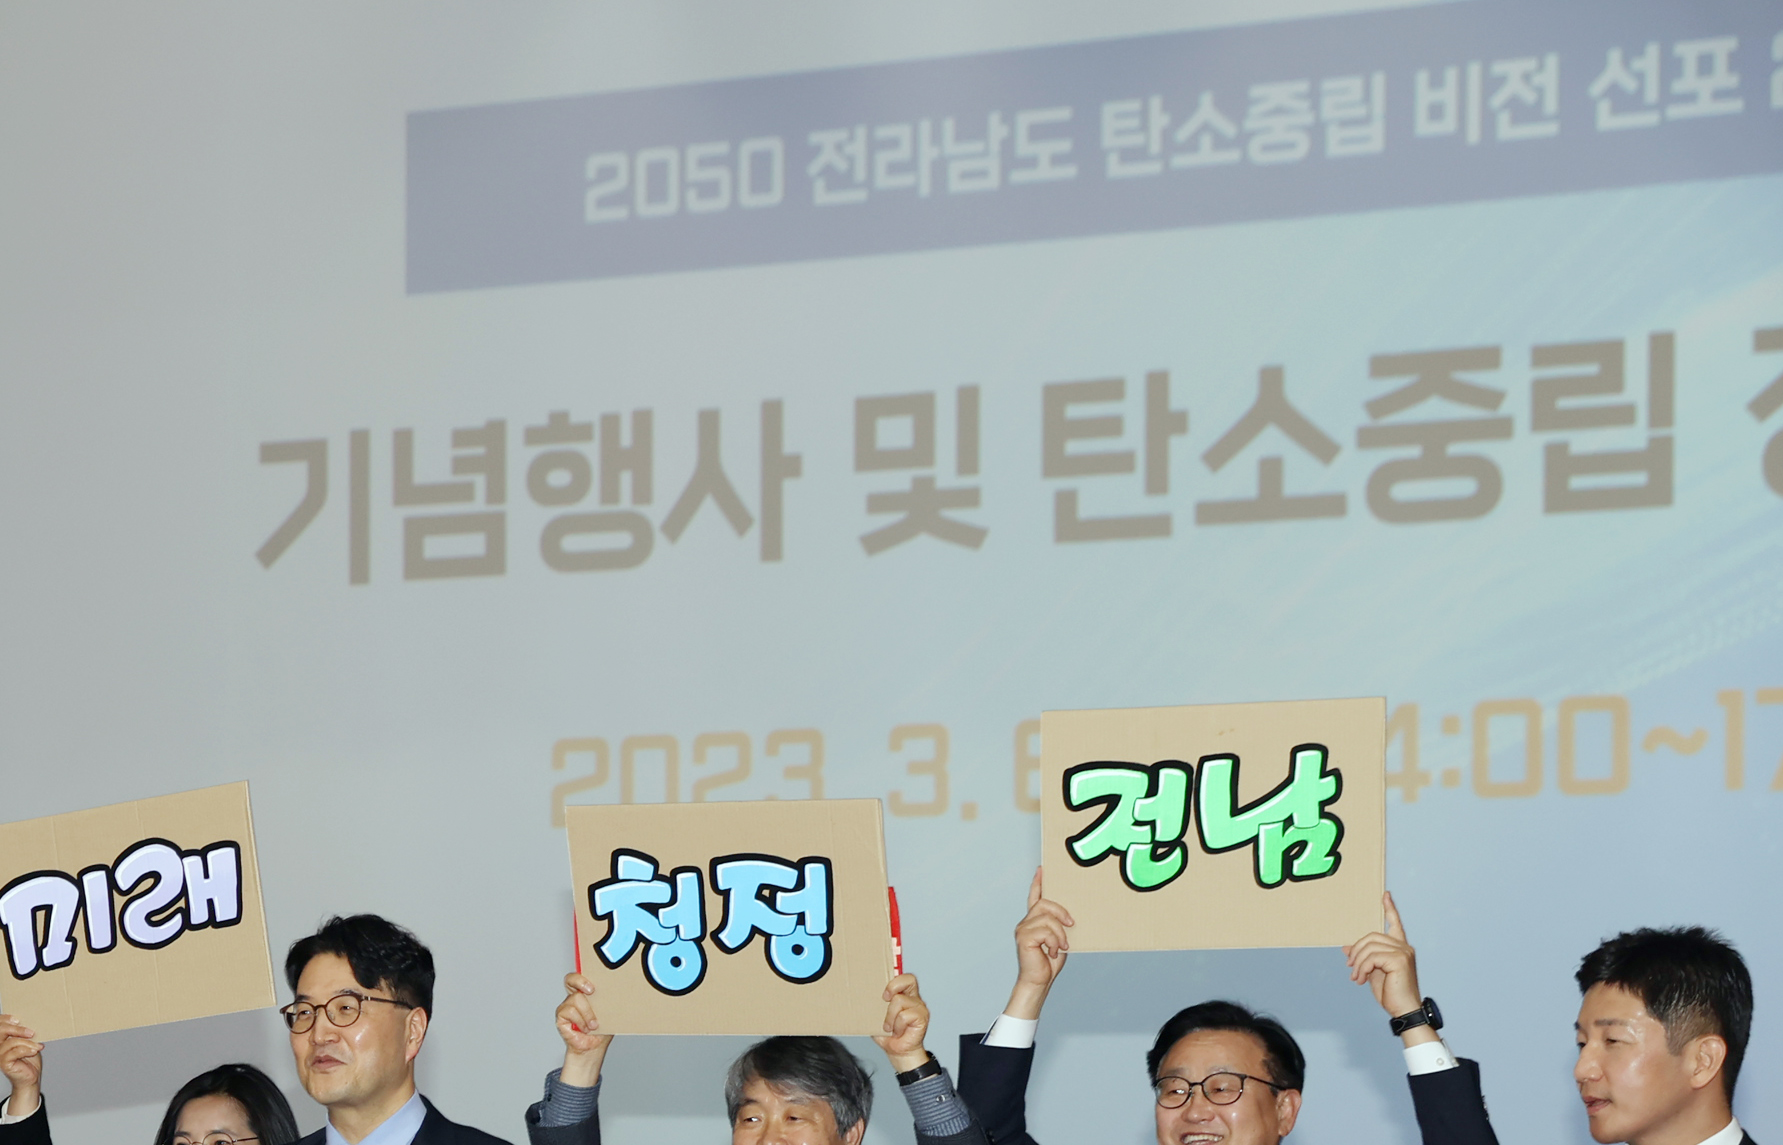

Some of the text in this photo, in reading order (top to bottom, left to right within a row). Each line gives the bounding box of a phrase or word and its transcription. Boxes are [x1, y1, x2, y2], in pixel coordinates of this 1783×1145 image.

[584, 137, 785, 224] 2050
[806, 108, 1079, 207] 전라남도
[1100, 72, 1387, 179] 탄소중립
[1414, 52, 1562, 146] 비전
[1586, 36, 1746, 131] 선포
[254, 397, 804, 586] 기념행사
[852, 384, 990, 556] 및
[1040, 330, 1677, 545] 탄소중립
[887, 723, 979, 822] 3.
[1063, 743, 1344, 890] 전남
[588, 849, 833, 995] 청정
